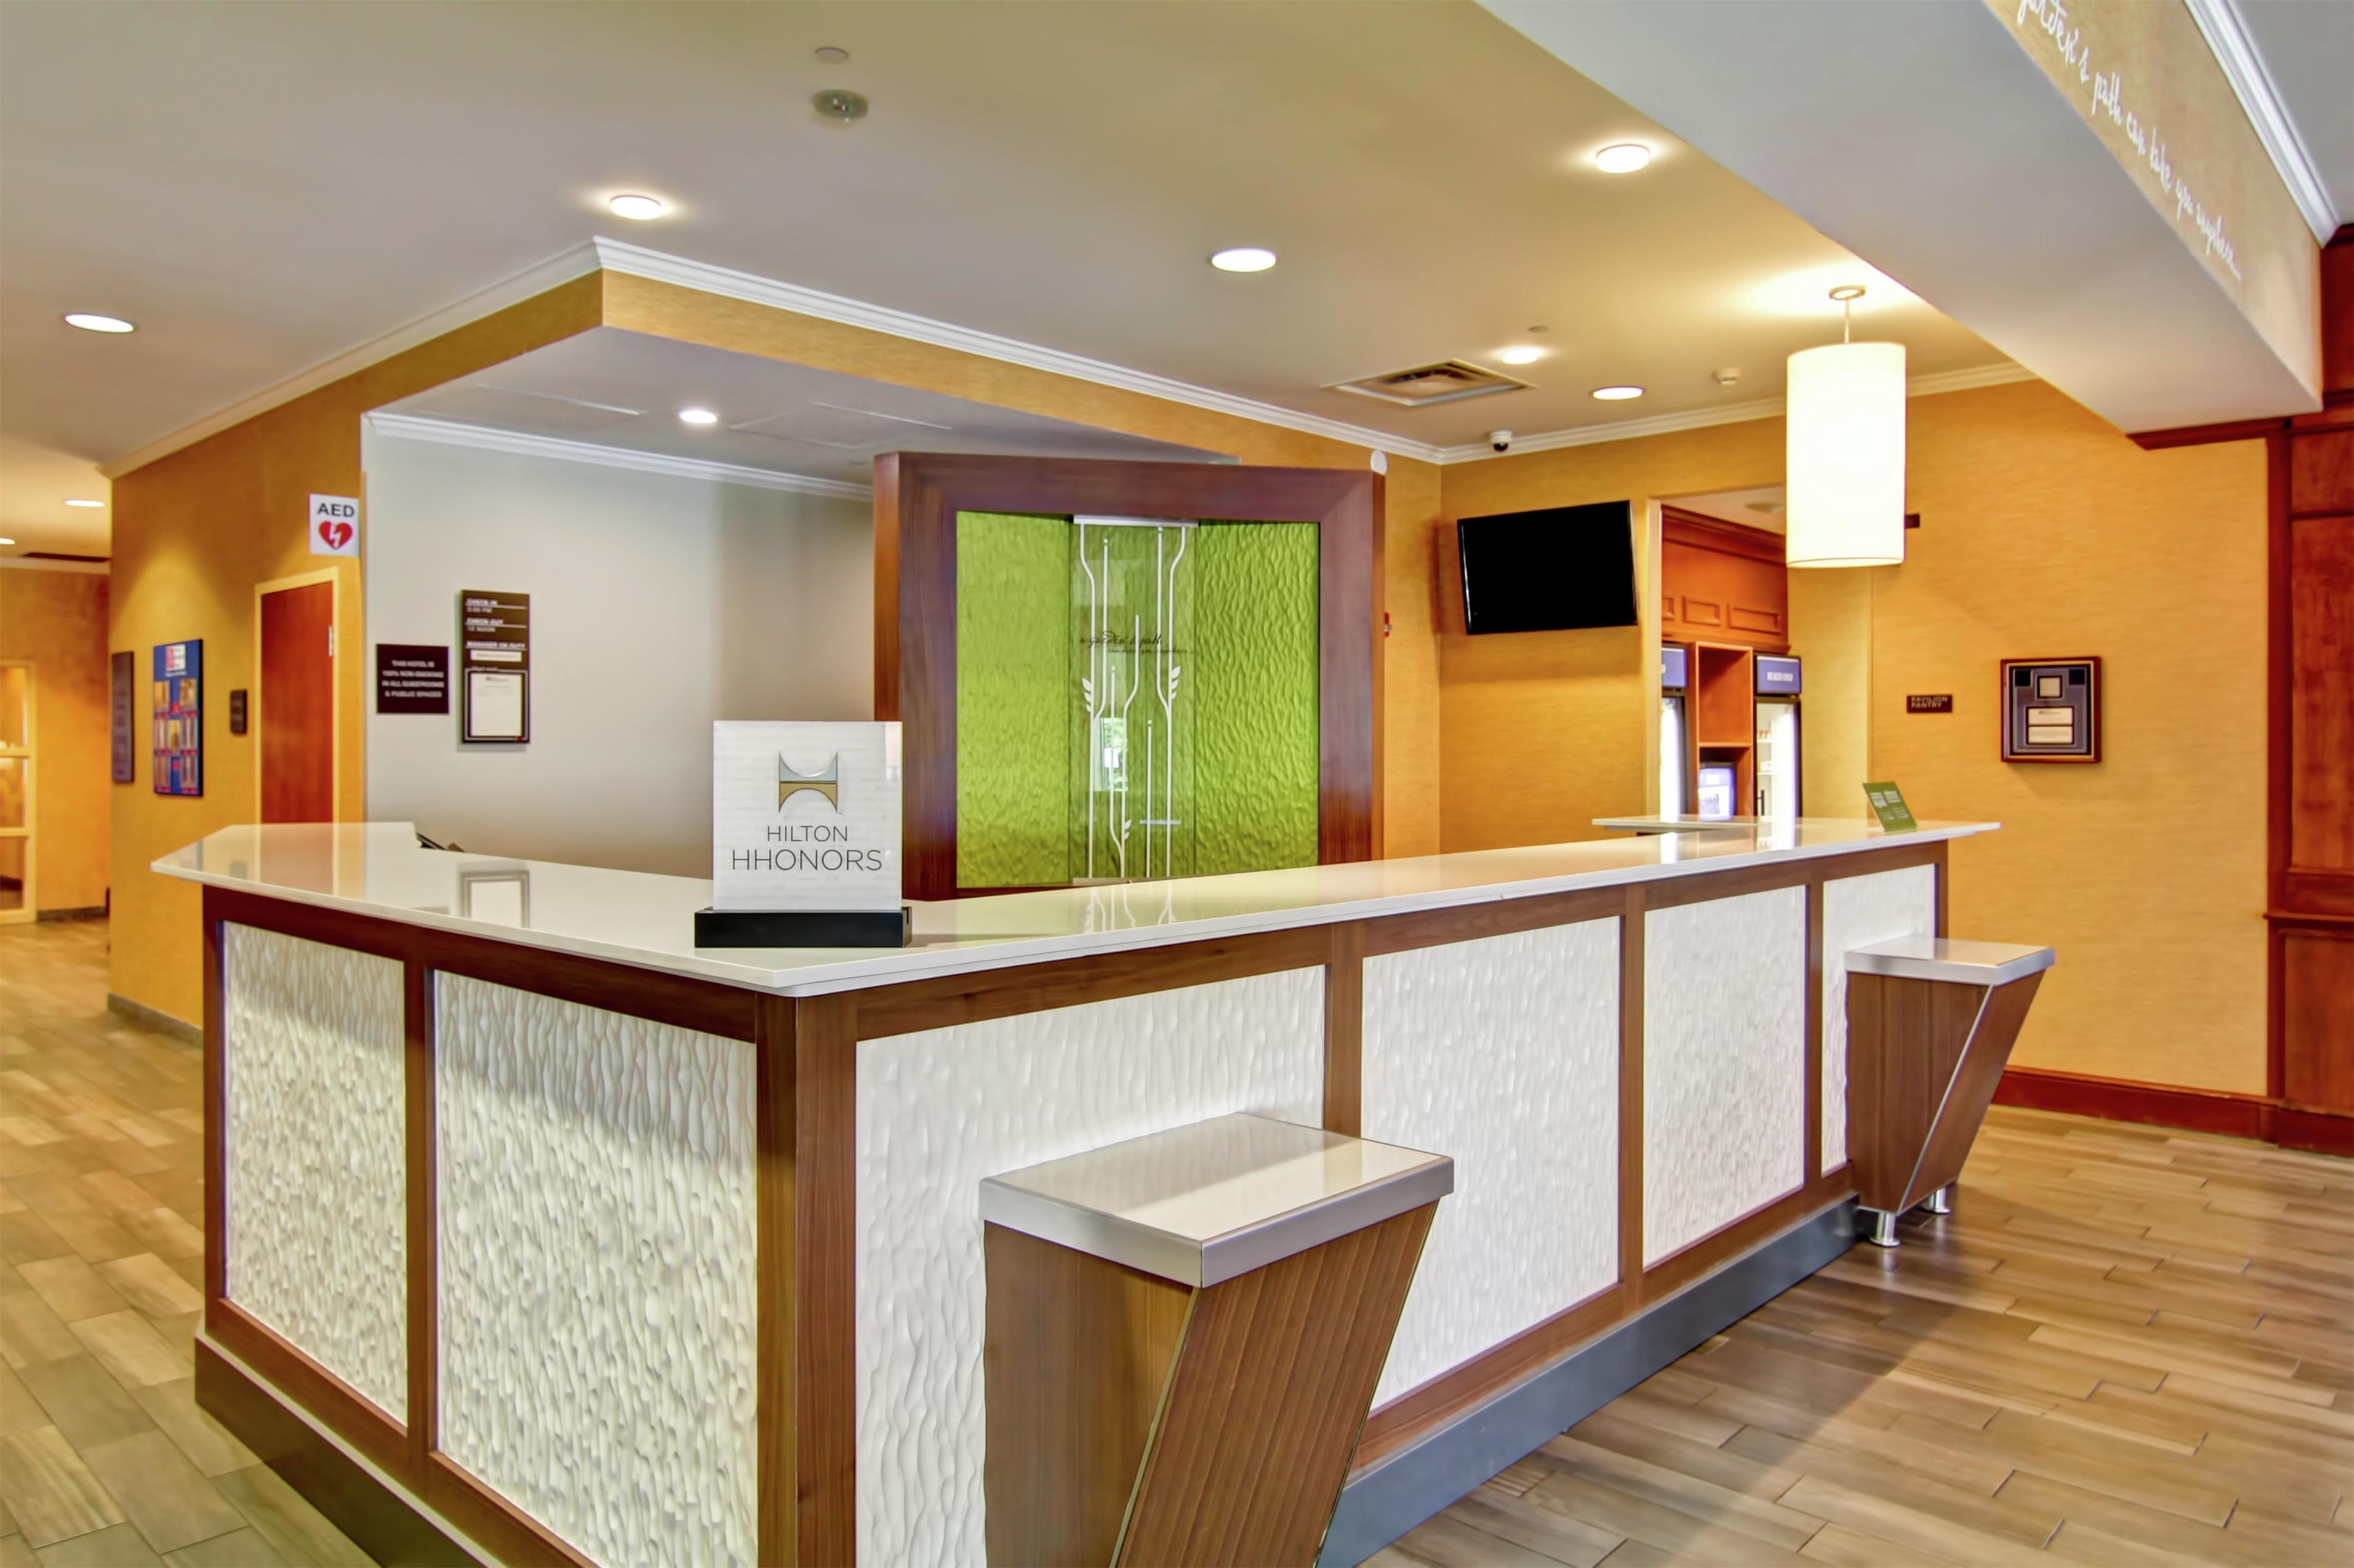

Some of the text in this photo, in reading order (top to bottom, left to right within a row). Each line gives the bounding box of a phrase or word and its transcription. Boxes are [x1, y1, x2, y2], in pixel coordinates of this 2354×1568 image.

[2092, 71, 2123, 126] path
[2126, 112, 2147, 156] can
[2150, 127, 2172, 193] take
[2175, 177, 2193, 220] you
[317, 503, 354, 518] AED
[767, 825, 847, 842] HILTON
[732, 849, 882, 871] HHONORS
